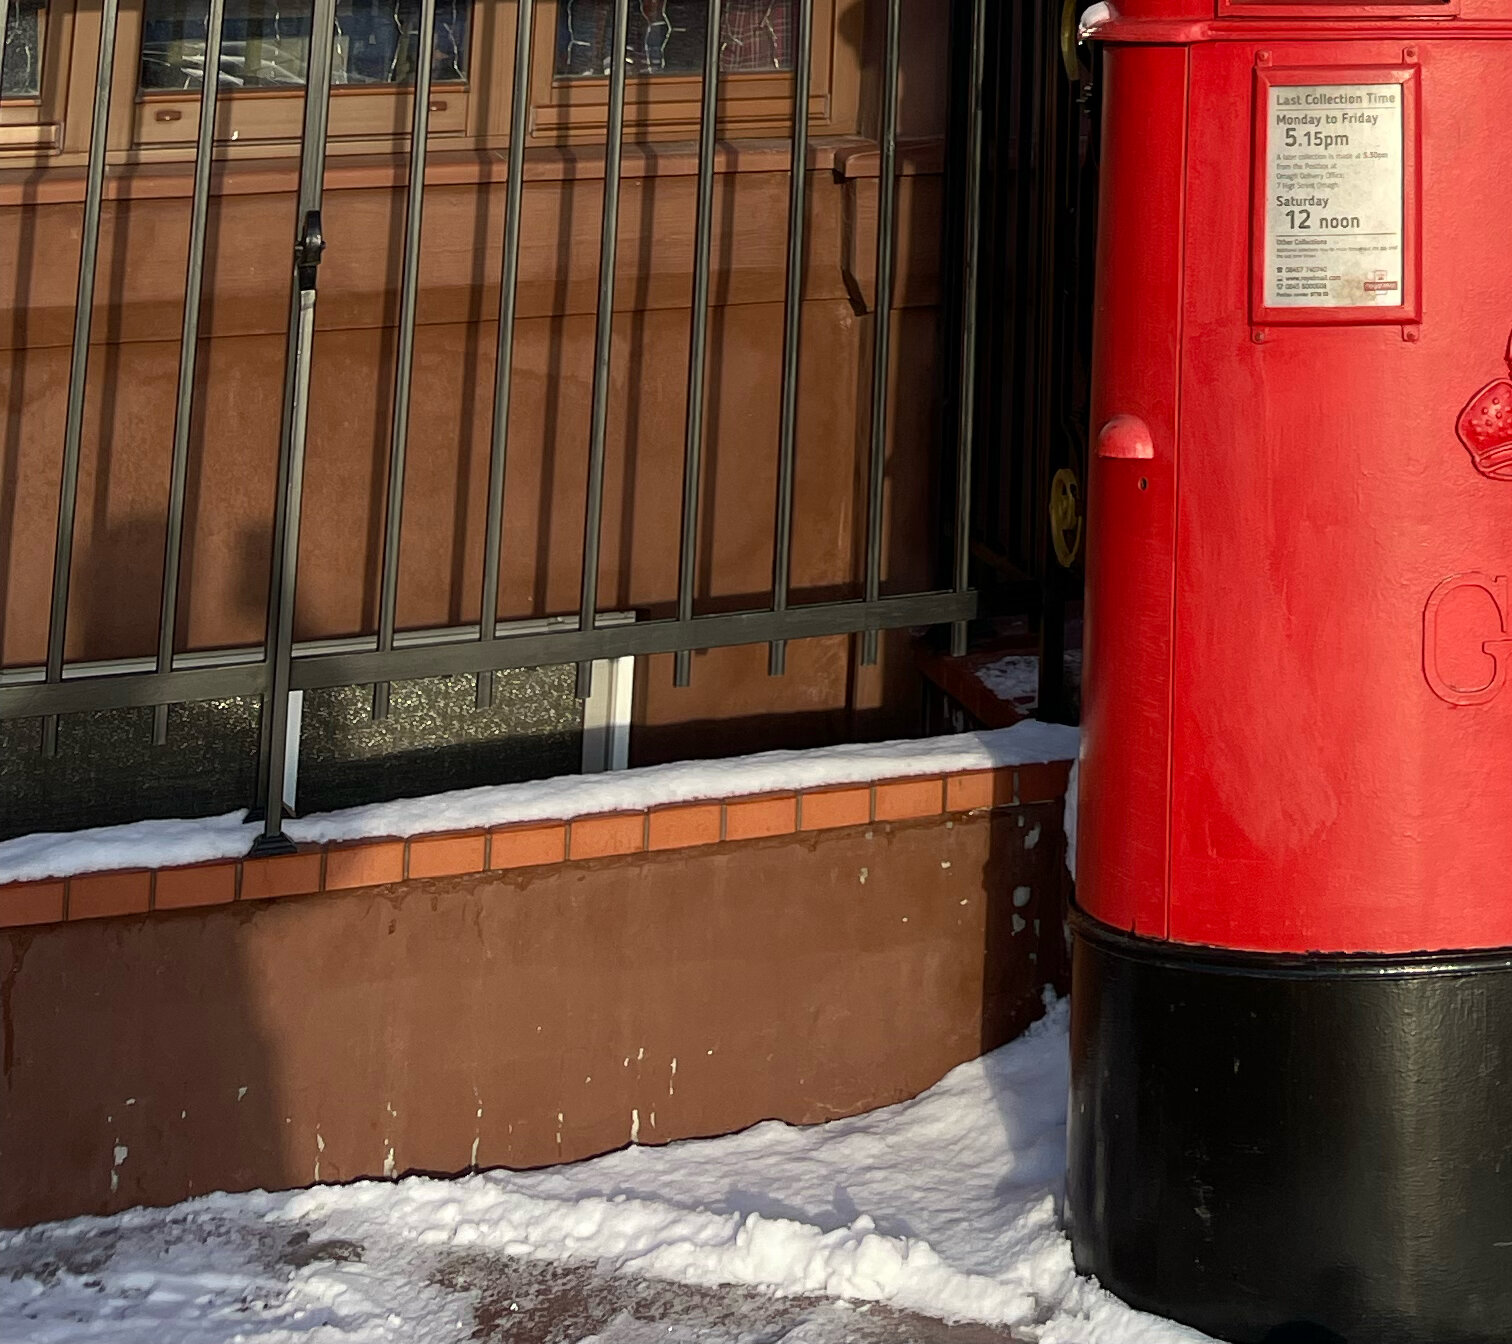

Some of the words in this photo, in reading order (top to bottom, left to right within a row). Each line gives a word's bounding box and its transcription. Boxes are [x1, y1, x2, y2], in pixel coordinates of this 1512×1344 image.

[1276, 94, 1302, 105] Last
[1305, 93, 1363, 105] Collection
[1366, 93, 1396, 104] Time
[1276, 114, 1321, 127] Monday
[1326, 115, 1337, 124] to
[1342, 113, 1379, 125] Friday
[1285, 127, 1349, 150] 5.15pm
[1276, 195, 1329, 209] Saturday
[1285, 209, 1311, 229] 12
[1319, 216, 1360, 229] noon
